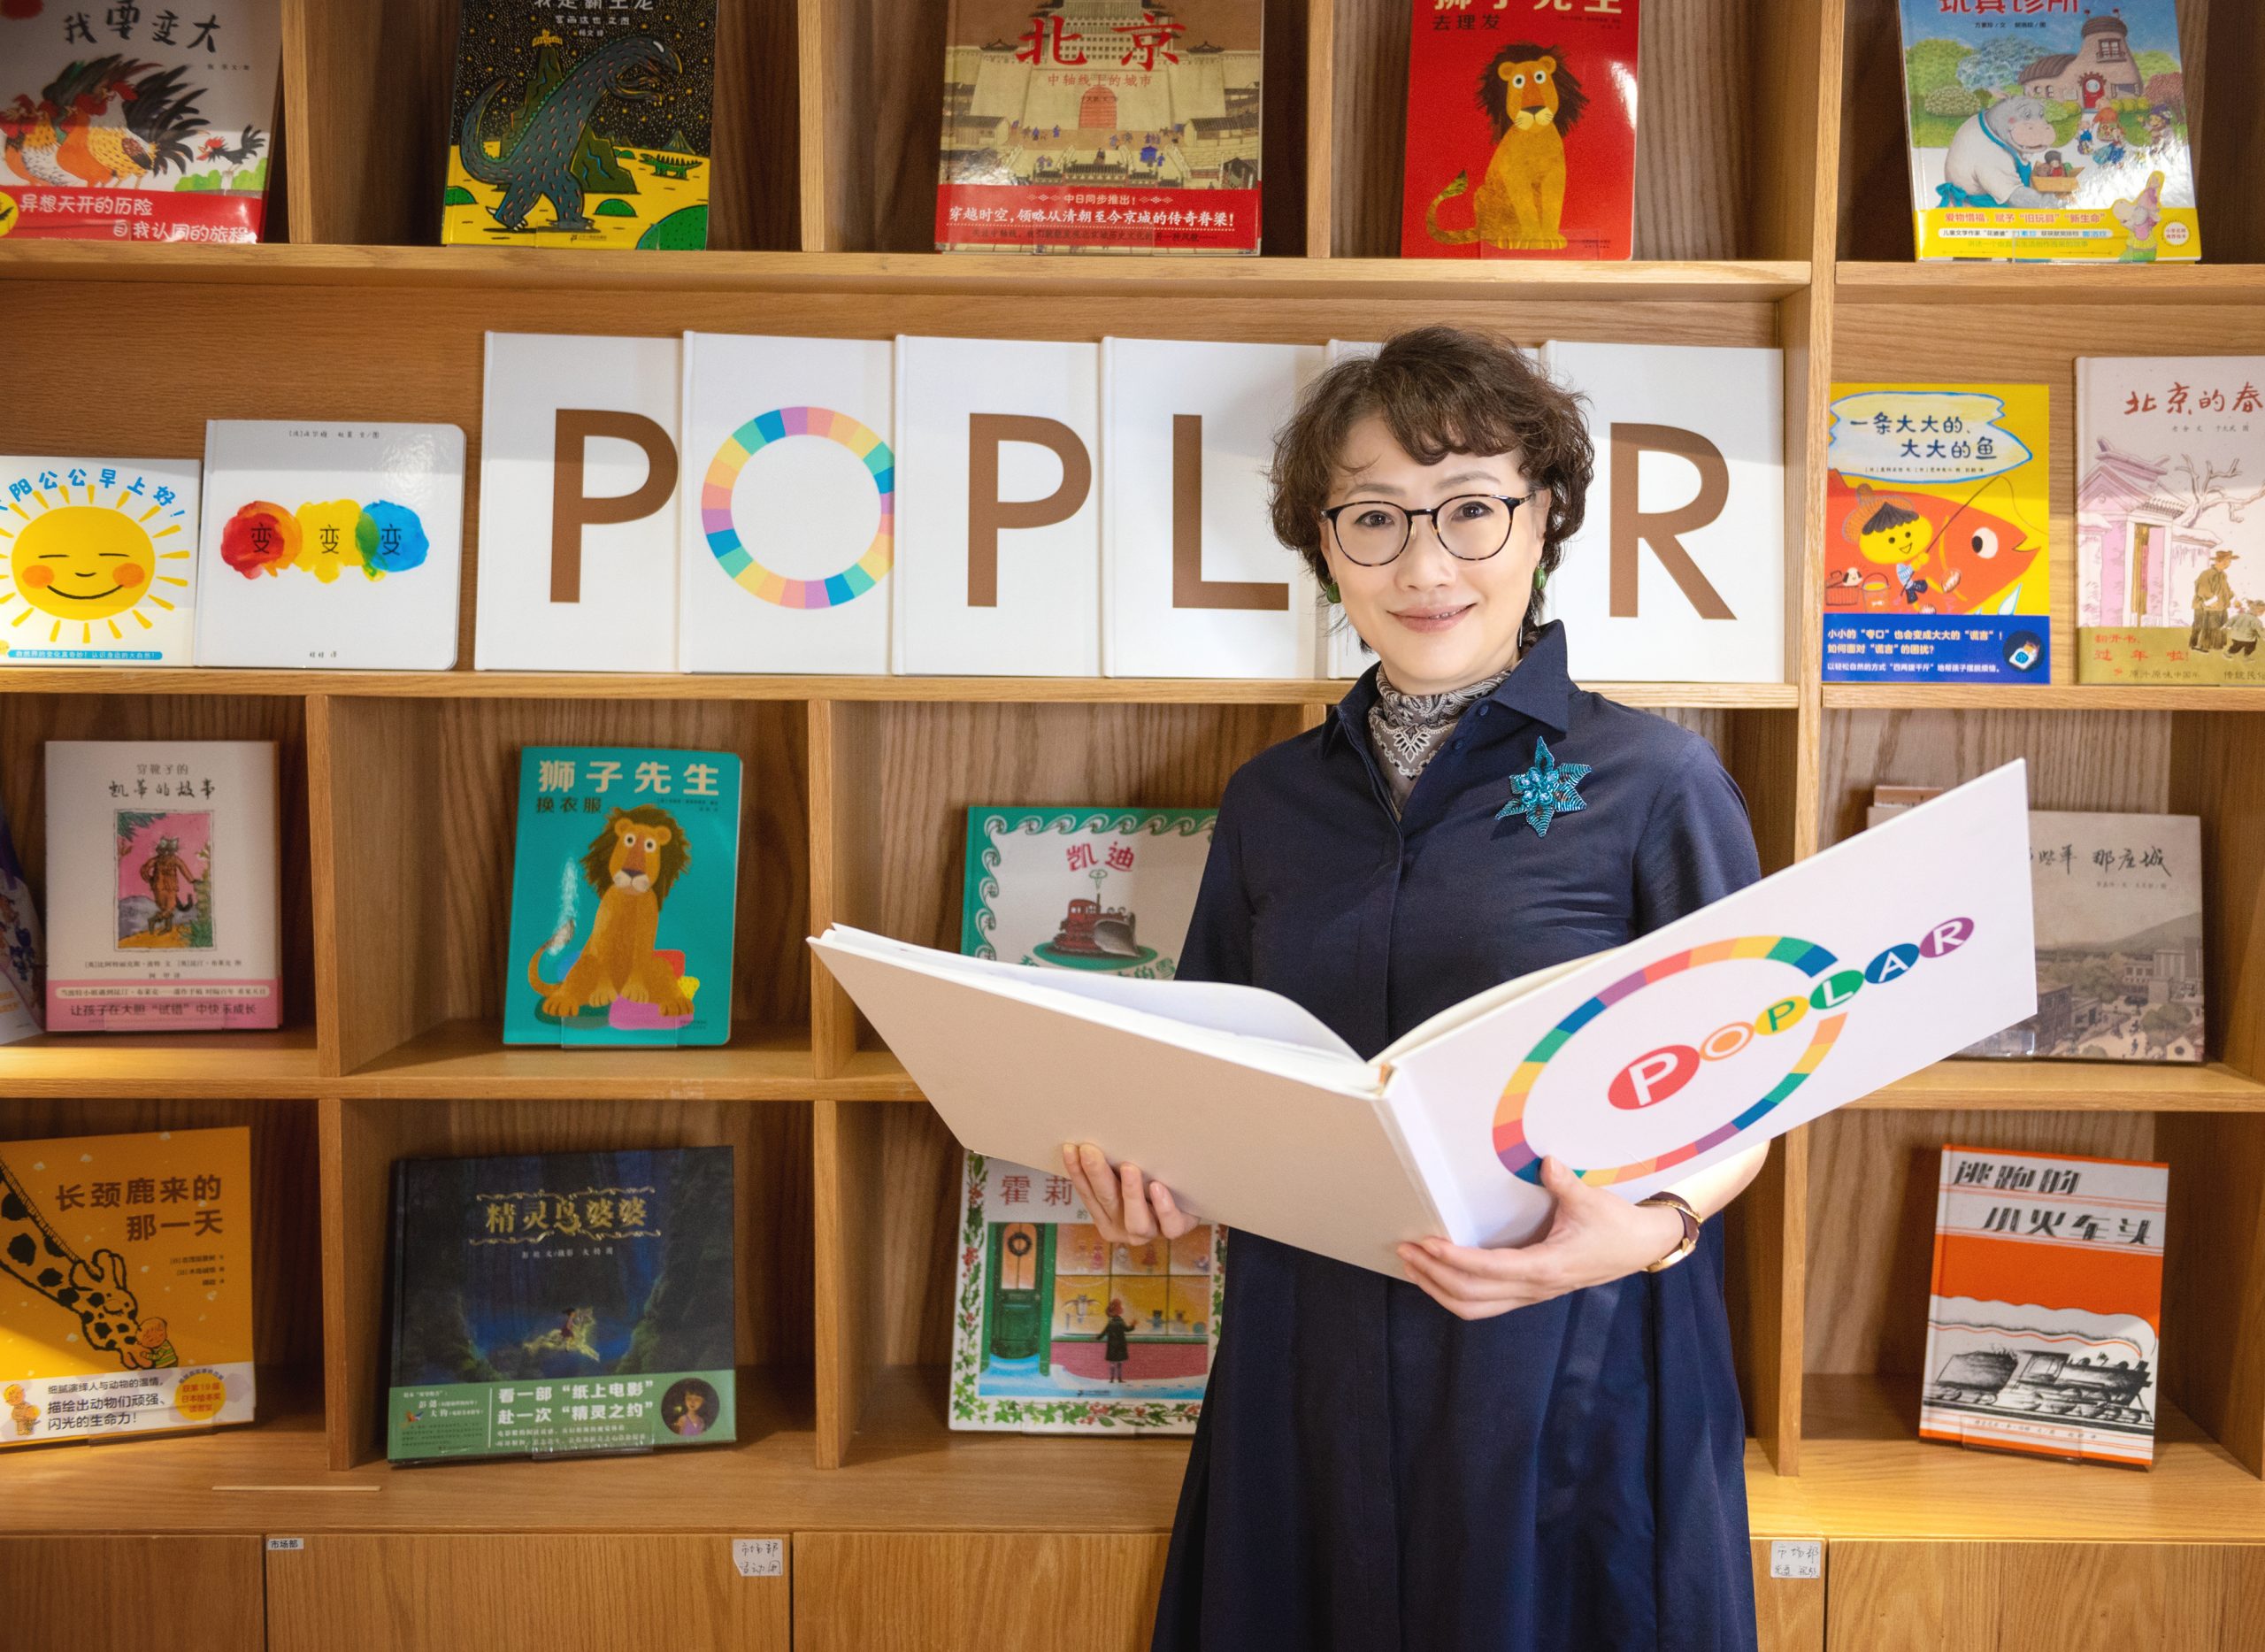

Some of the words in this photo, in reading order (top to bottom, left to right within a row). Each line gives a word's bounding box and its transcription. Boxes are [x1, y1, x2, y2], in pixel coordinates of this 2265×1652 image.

[64, 0, 220, 52] 我要变大
[1432, 14, 1501, 31] 去理发
[1016, 13, 1186, 72] 北京
[1048, 73, 1153, 88] 中轴线上的城市
[20, 194, 153, 217] 异想天开的历险
[112, 219, 251, 243] 自我认同的旅程
[2124, 382, 2264, 415] 北京的春
[1901, 436, 1997, 459] 大大的鱼
[0, 467, 186, 517] 阳公公早上好！
[539, 760, 719, 795] 狮子先生
[536, 797, 602, 813] 换衣服
[1066, 841, 1135, 872] 凯迪
[2030, 843, 2077, 875] 些年
[1619, 918, 1968, 1108] POPLAR
[56, 1174, 222, 1212] 长颈鹿来的
[1000, 1175, 1073, 1206] 霍莉
[1954, 1160, 2082, 1195] 逃跑的
[127, 1209, 224, 1242] 那一天
[486, 1196, 647, 1236] 精灵鸟婆婆
[1983, 1206, 2153, 1245] 小火车头
[47, 1393, 165, 1415] 描绘出动物们顽强、
[498, 1379, 653, 1404] 看一部“纸上电影”
[47, 1412, 137, 1431] 闪光的生命力！
[497, 1401, 653, 1425] 赴一次“精灵之约”
[270, 1540, 299, 1548] 市场部
